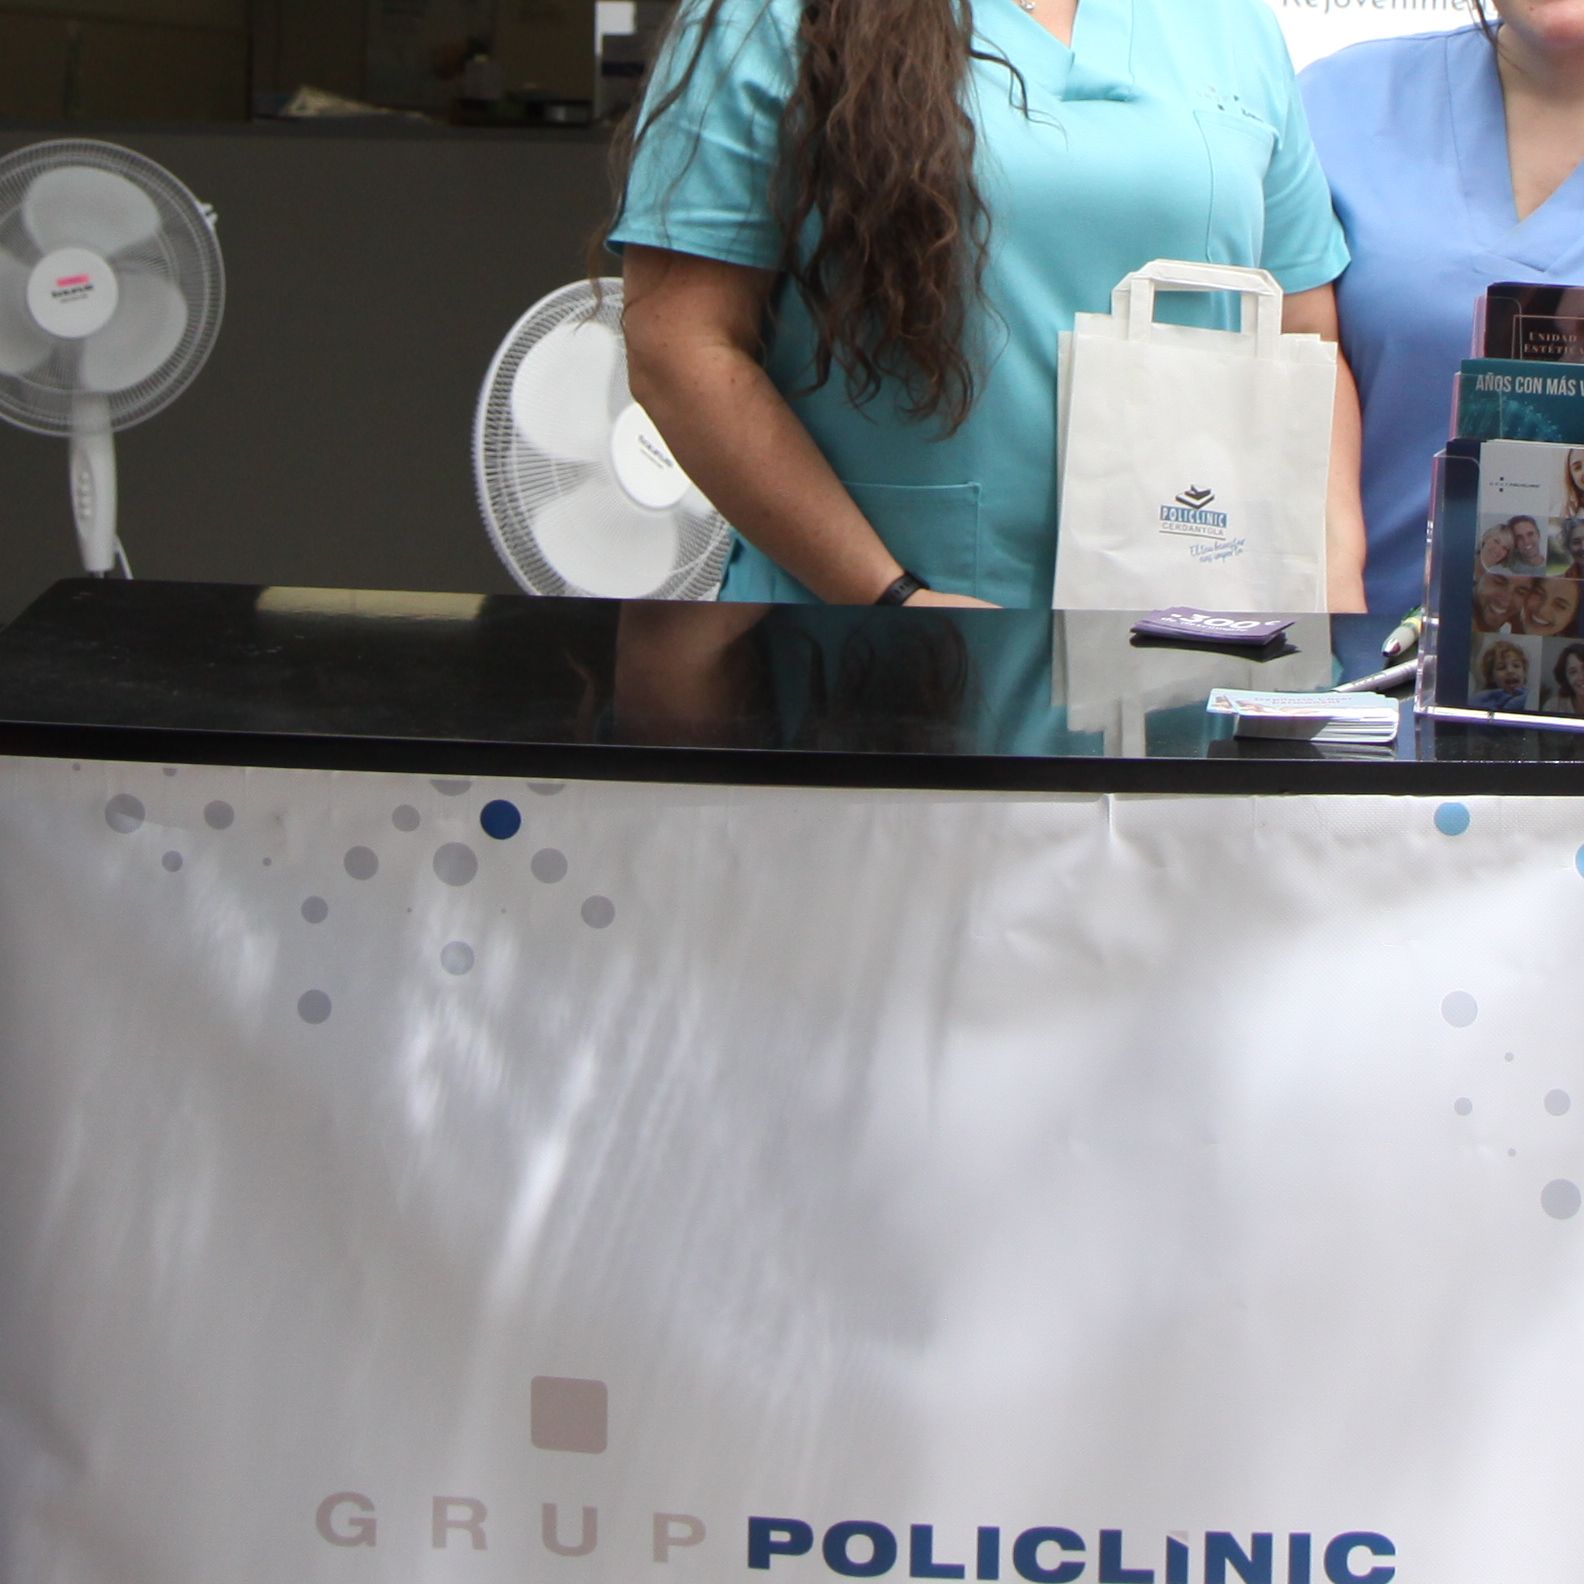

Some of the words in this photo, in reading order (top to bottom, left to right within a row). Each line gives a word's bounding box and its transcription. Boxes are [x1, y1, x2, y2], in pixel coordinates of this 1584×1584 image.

[1475, 373, 1512, 393] AÑOS
[1515, 377, 1543, 394] CON
[1546, 375, 1576, 397] MÁS
[1162, 506, 1225, 528] POLICLINIC
[316, 1491, 707, 1564] GRUP
